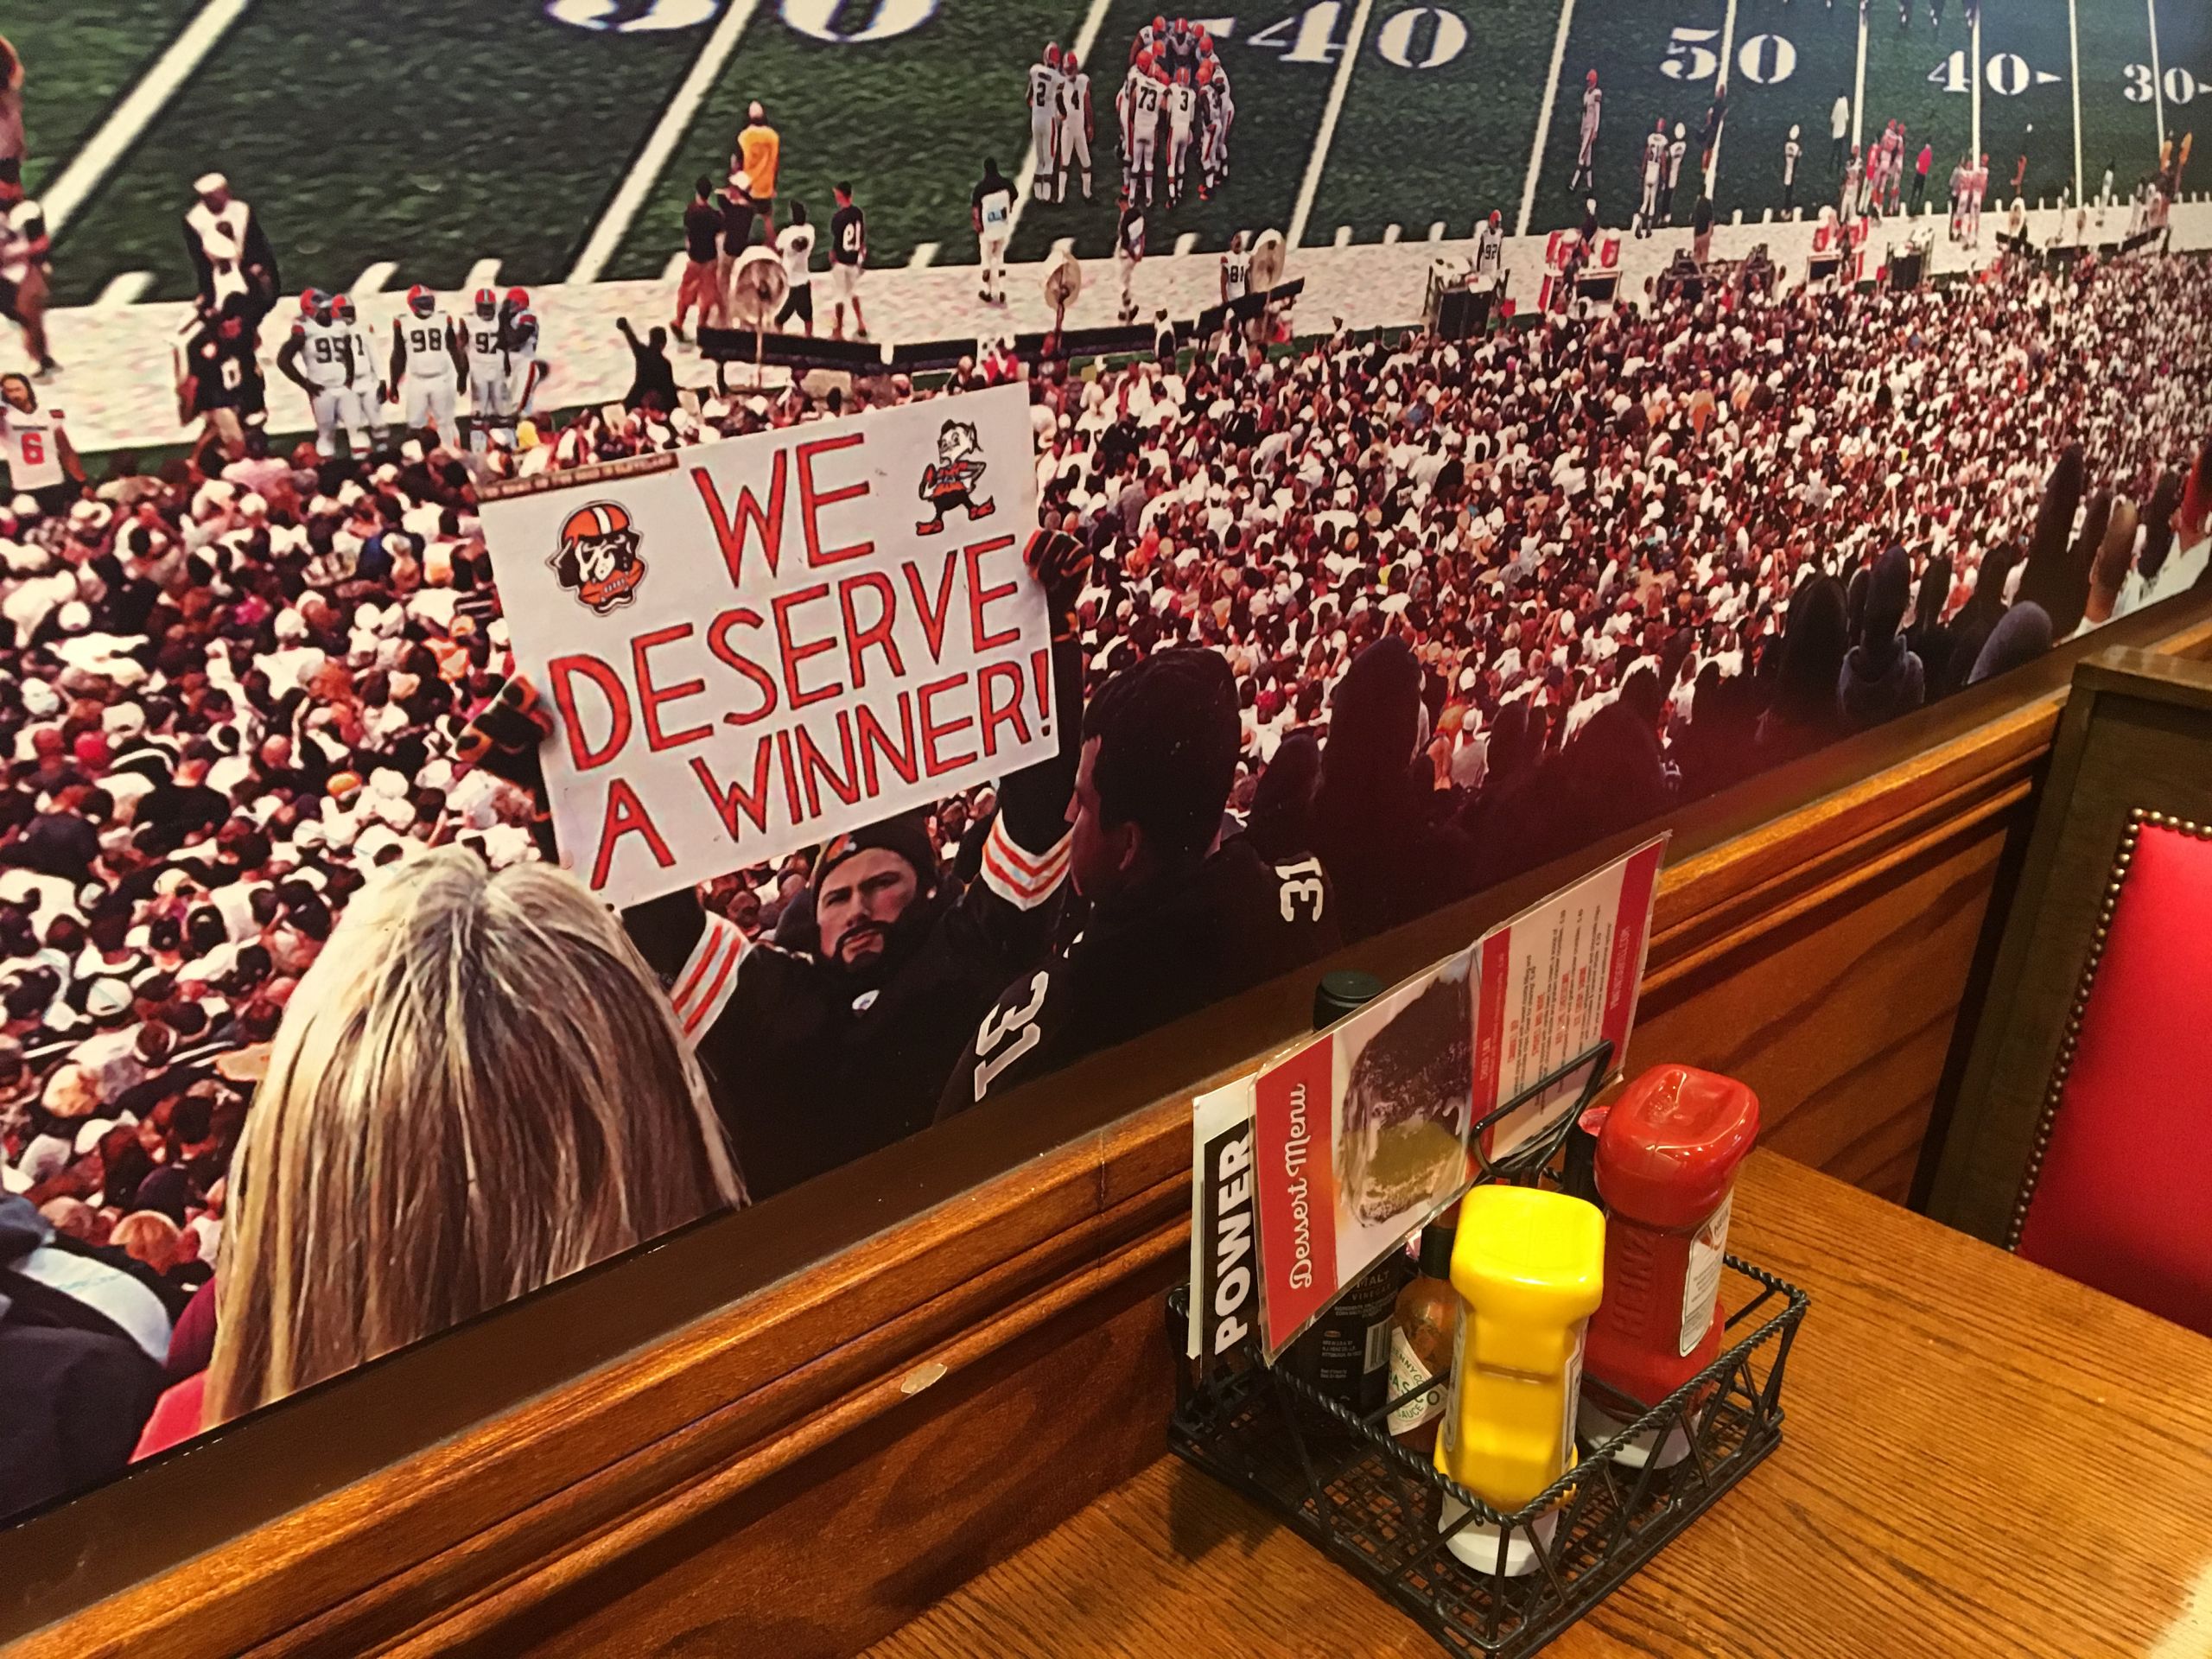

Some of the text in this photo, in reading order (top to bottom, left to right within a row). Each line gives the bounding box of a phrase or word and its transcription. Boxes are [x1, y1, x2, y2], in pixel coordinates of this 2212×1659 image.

[1660, 27, 1798, 85] 50
[1927, 49, 2030, 96] 40
[1138, 86, 1159, 112] 73
[1179, 90, 1190, 112] 3
[2123, 63, 2195, 105] 30
[410, 327, 442, 353] 98
[21, 432, 45, 465] 6
[691, 432, 875, 588] WE
[549, 534, 1021, 771] DESERVE
[590, 650, 1052, 891] A WINNER!
[1284, 1082, 1313, 1290] Dessert Menu
[1214, 1131, 1252, 1357] POWER
